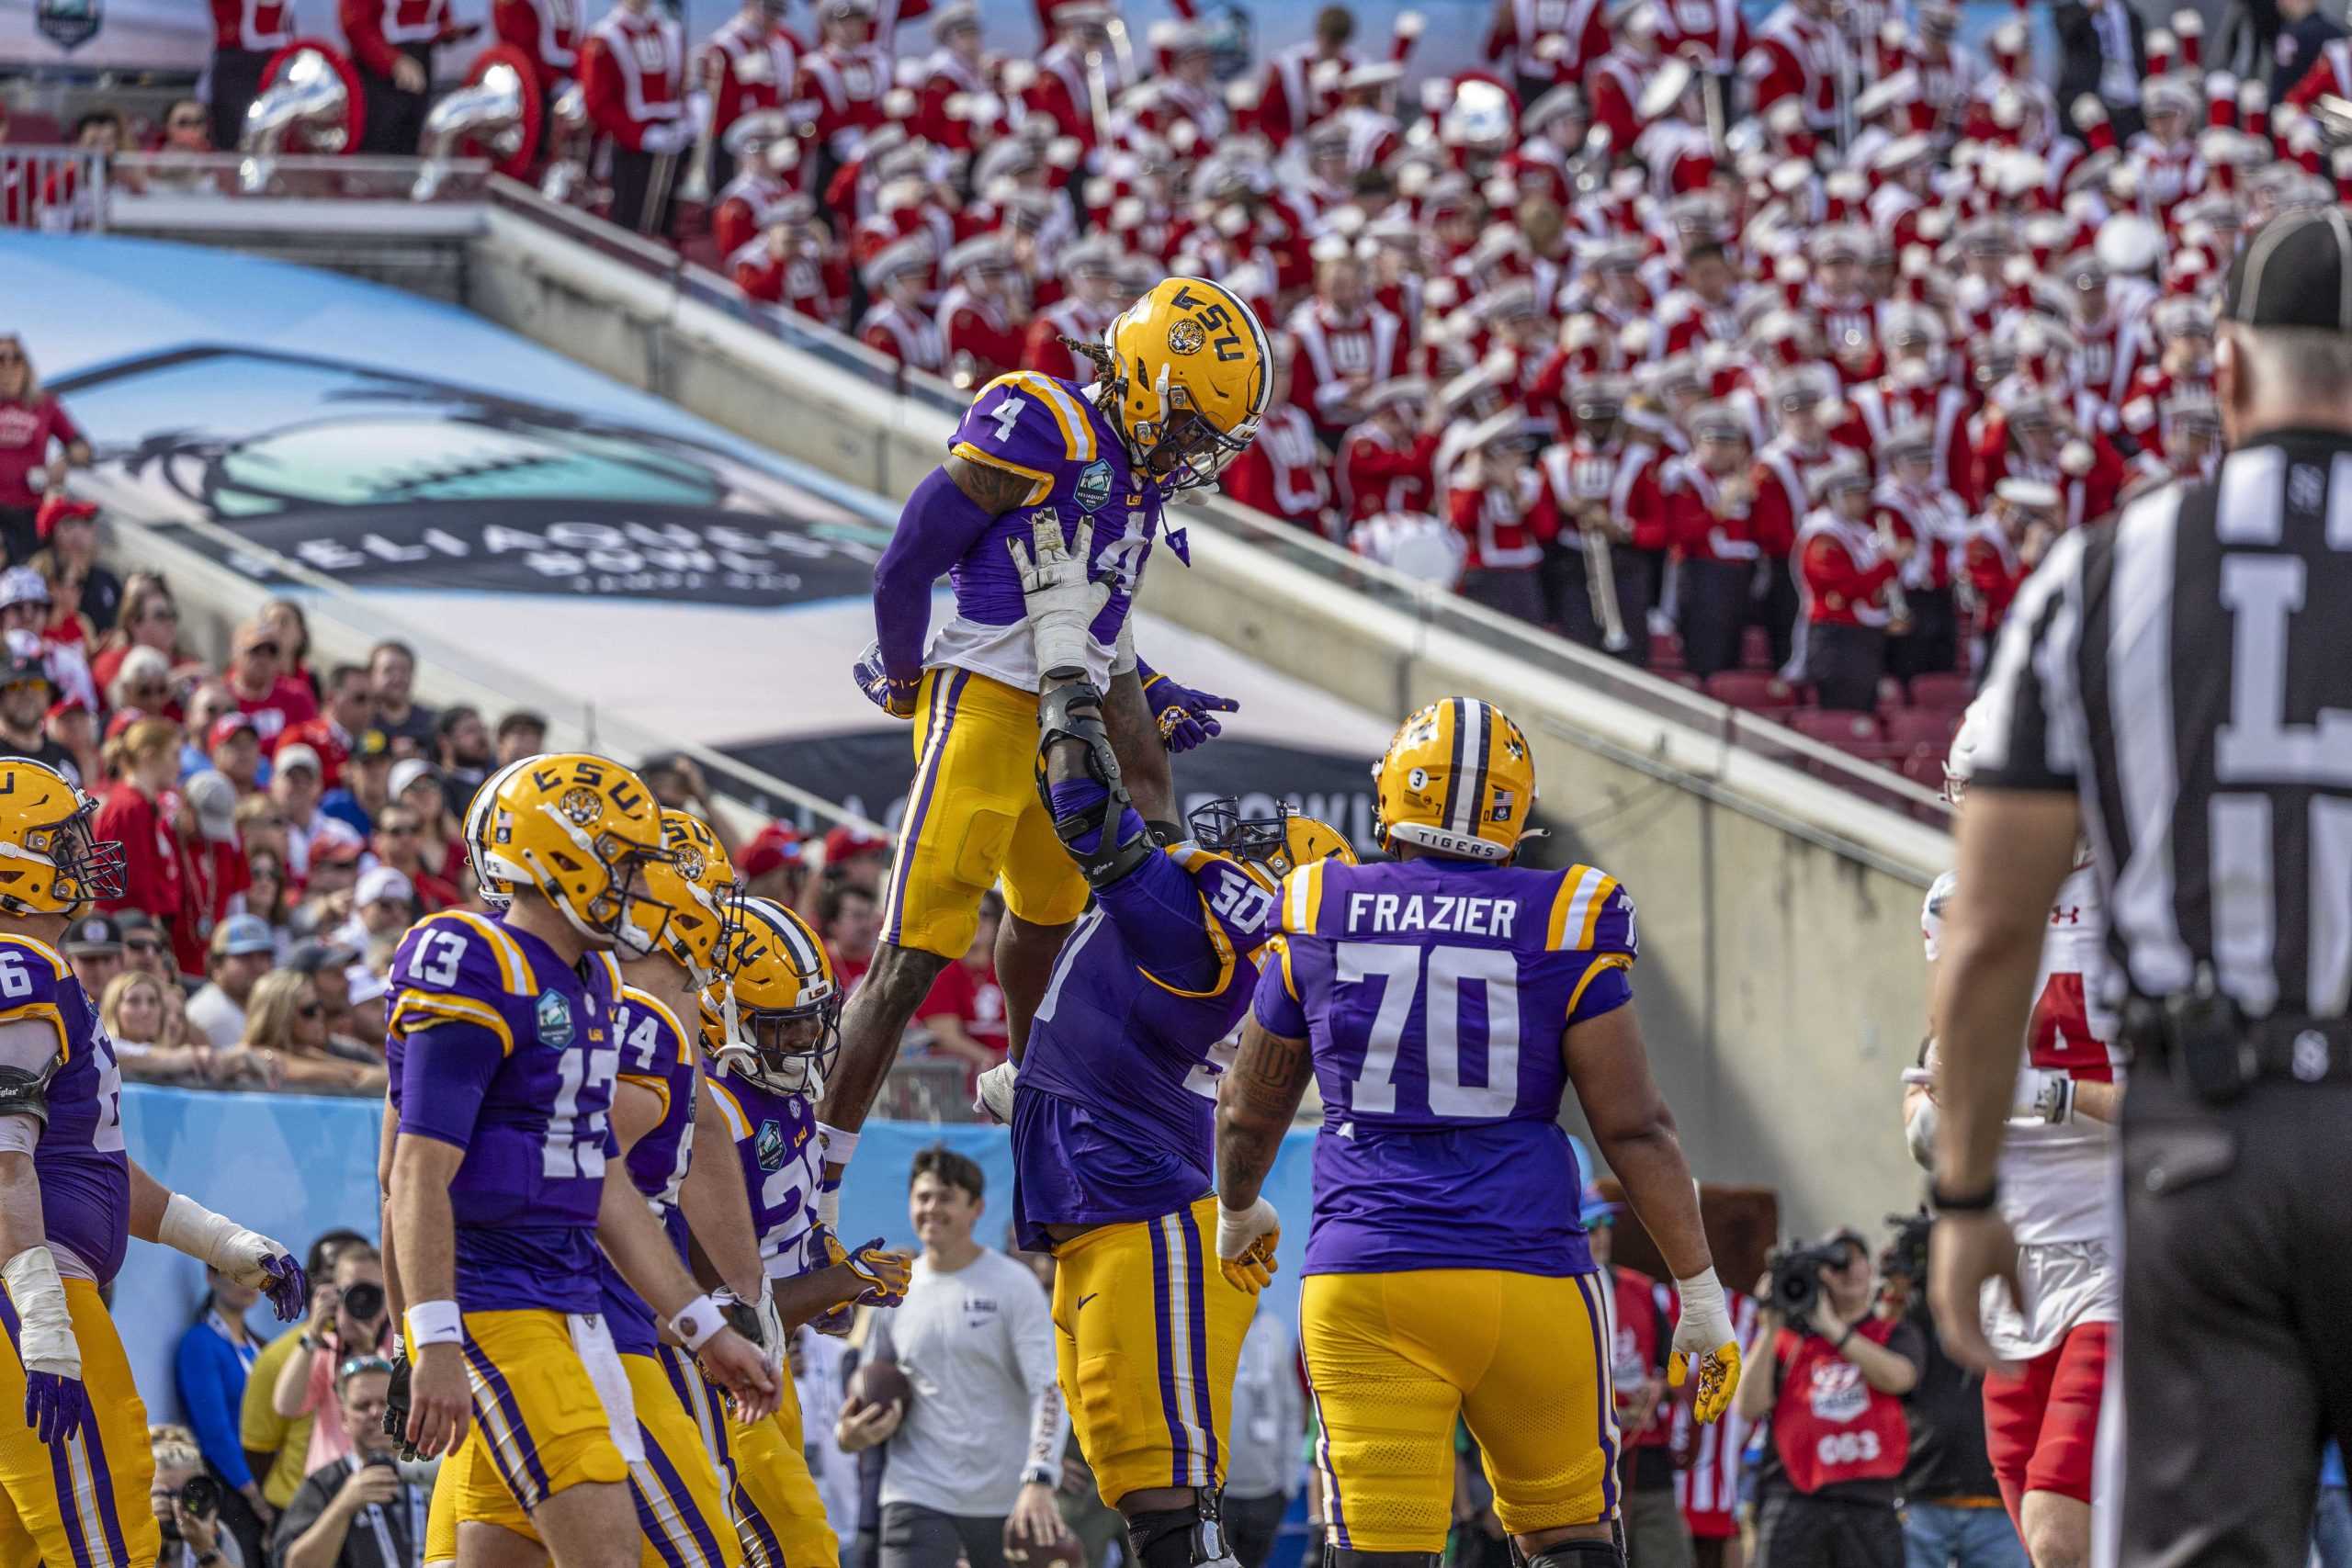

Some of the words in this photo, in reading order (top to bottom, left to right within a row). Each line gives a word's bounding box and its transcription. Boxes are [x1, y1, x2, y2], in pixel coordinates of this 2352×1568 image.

[1171, 286, 1245, 362] LSU
[990, 397, 1026, 443] 4
[1094, 511, 1149, 596] 4
[533, 762, 642, 820] LSU
[1413, 771, 1423, 787] 3
[662, 818, 714, 846] SU
[1435, 803, 1442, 816] 7
[1419, 830, 1497, 858] TIGERS
[1211, 869, 1274, 935] 50
[1348, 892, 1518, 939] FRAZIER
[408, 928, 469, 987] 13
[1335, 941, 1520, 1118] 70
[2027, 972, 2114, 1083] 4
[542, 1047, 620, 1179] 13
